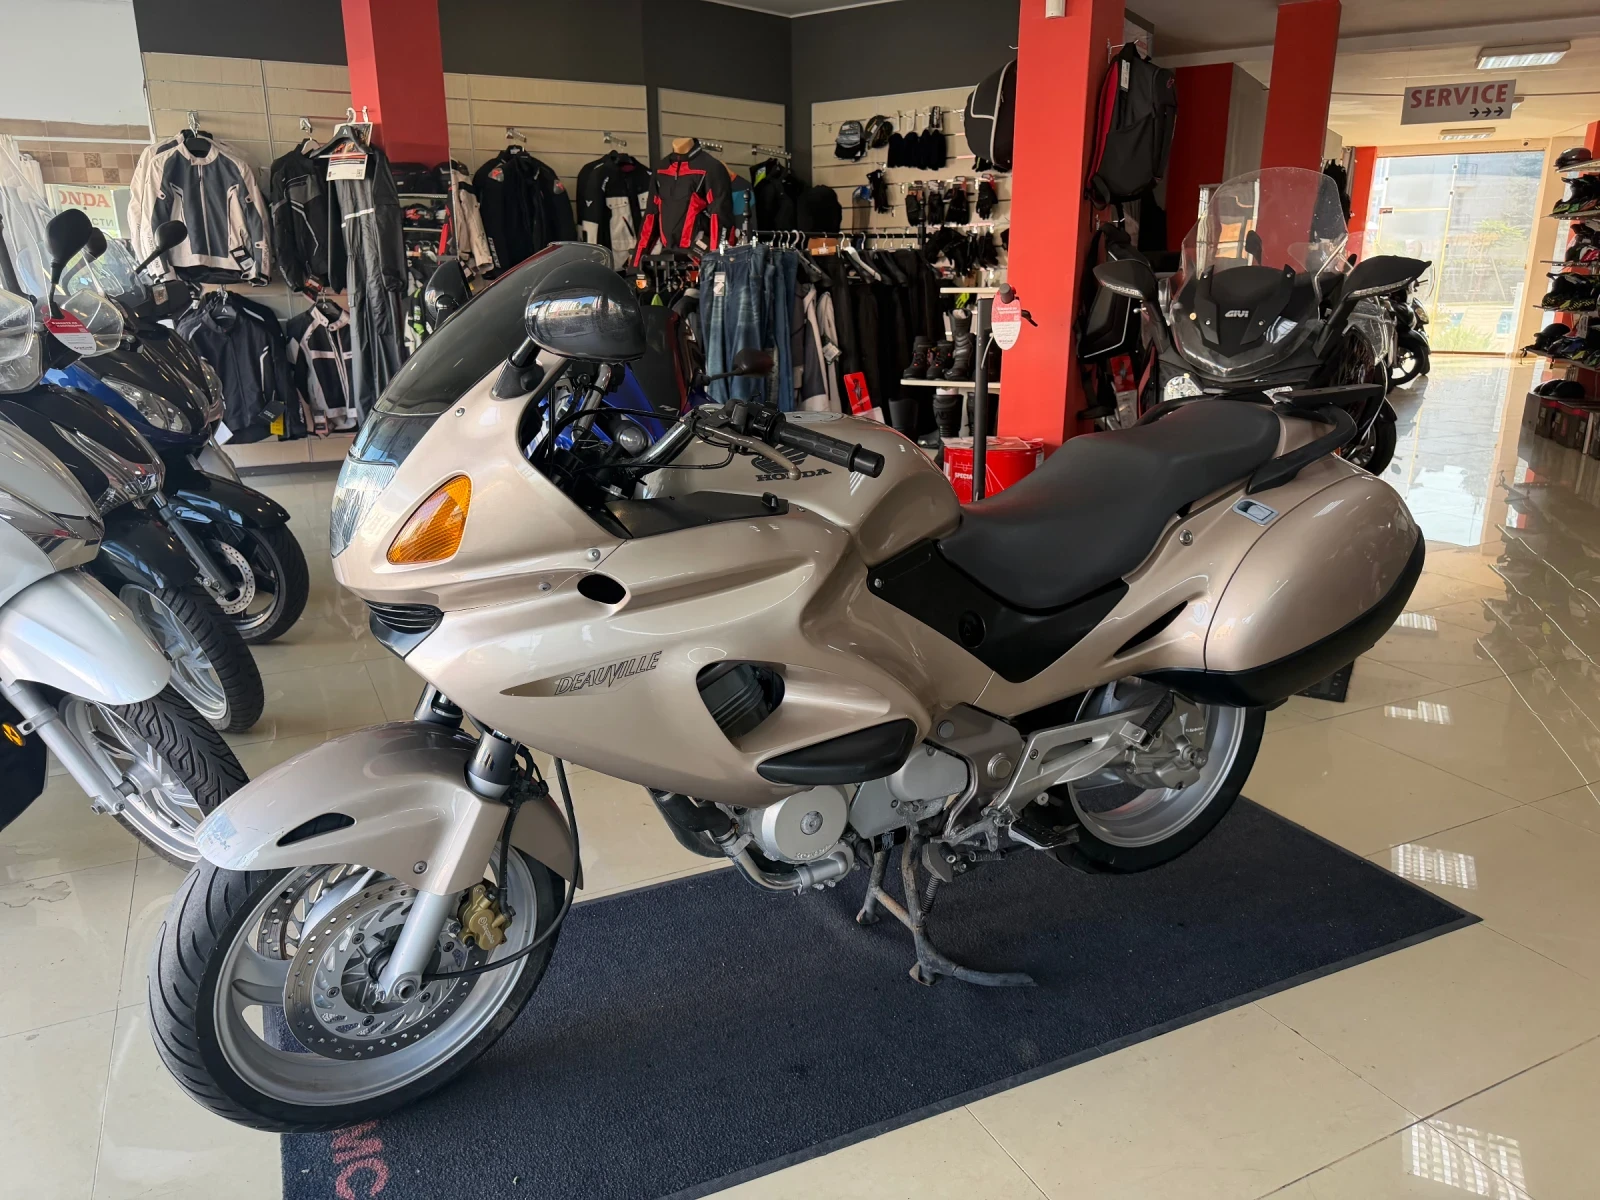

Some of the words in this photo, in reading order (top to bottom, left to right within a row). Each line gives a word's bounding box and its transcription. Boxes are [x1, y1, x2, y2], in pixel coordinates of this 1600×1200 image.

[1410, 83, 1508, 109] SERVICE
[1224, 309, 1250, 318] GIVI
[954, 472, 973, 480] SPECIA
[554, 650, 663, 696] DEAUVILLE
